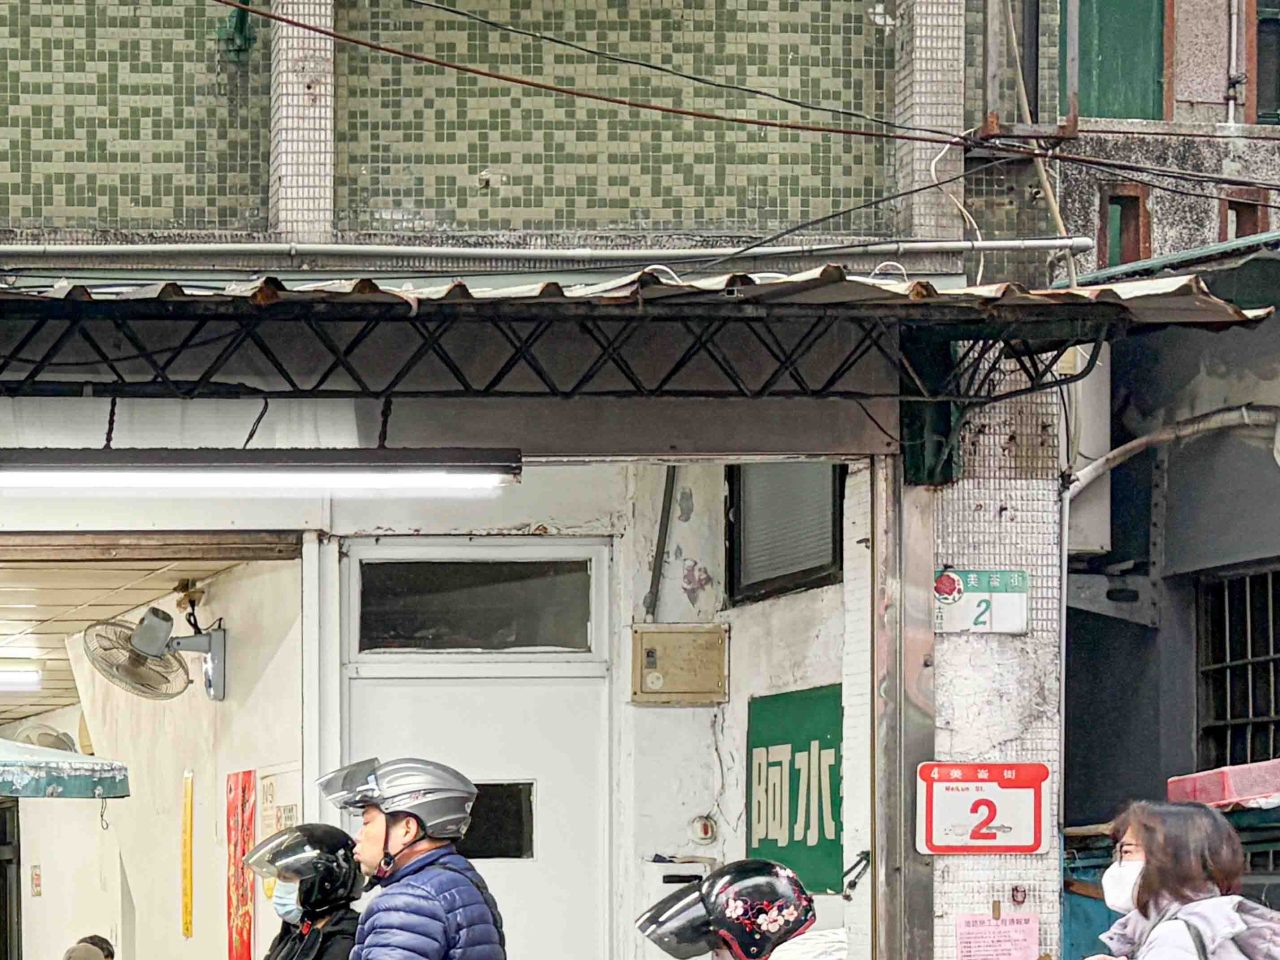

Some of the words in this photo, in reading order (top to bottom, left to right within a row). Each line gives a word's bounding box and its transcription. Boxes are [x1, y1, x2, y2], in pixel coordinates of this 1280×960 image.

[973, 598, 992, 626] 2
[930, 767, 939, 780] 4
[751, 738, 845, 848] 阿水
[969, 798, 997, 840] 2
